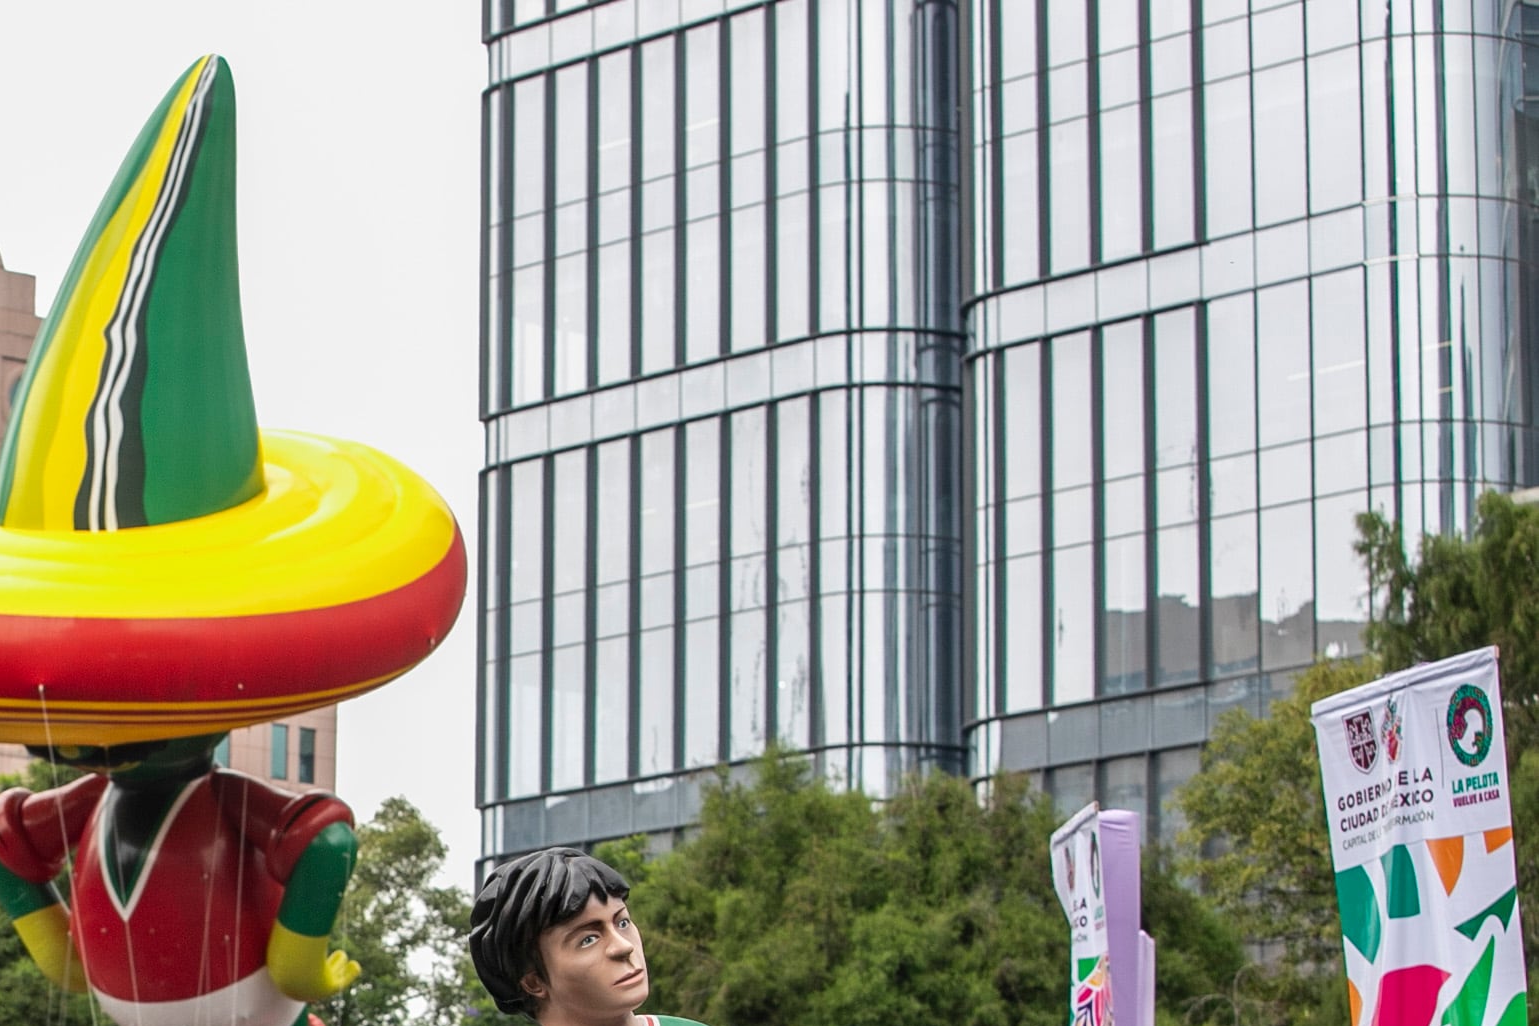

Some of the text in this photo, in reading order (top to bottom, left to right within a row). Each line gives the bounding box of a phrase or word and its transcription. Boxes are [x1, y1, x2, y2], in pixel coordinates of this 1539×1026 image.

[1413, 767, 1433, 783] LA
[1452, 771, 1499, 794] LA PELOTA
[1453, 788, 1500, 808] VUELVE A CASA
[1340, 807, 1379, 832] CIUDAD
